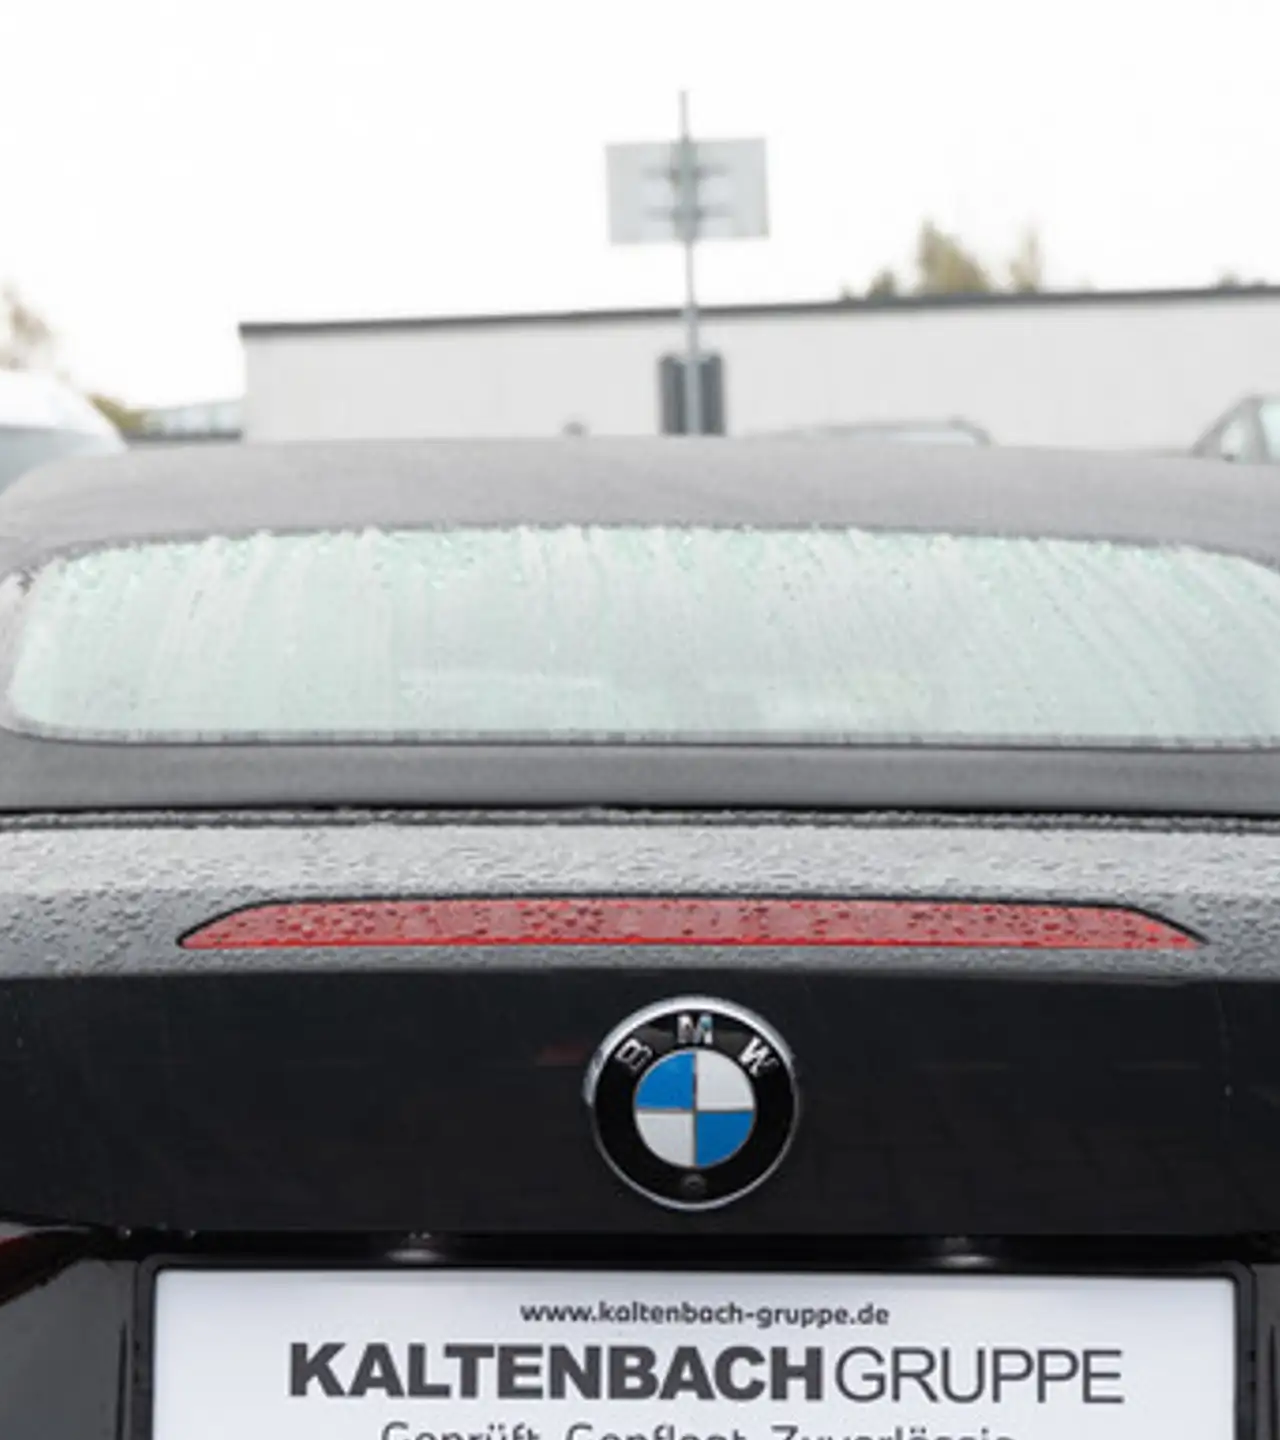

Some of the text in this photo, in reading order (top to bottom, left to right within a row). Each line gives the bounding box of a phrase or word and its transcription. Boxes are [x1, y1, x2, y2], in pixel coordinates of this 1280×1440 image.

[616, 1013, 777, 1076] BMW
[521, 1301, 889, 1329] www.kaltenbach-gruppe.de
[289, 1342, 1124, 1404] KALTENBACHGRUPPE
